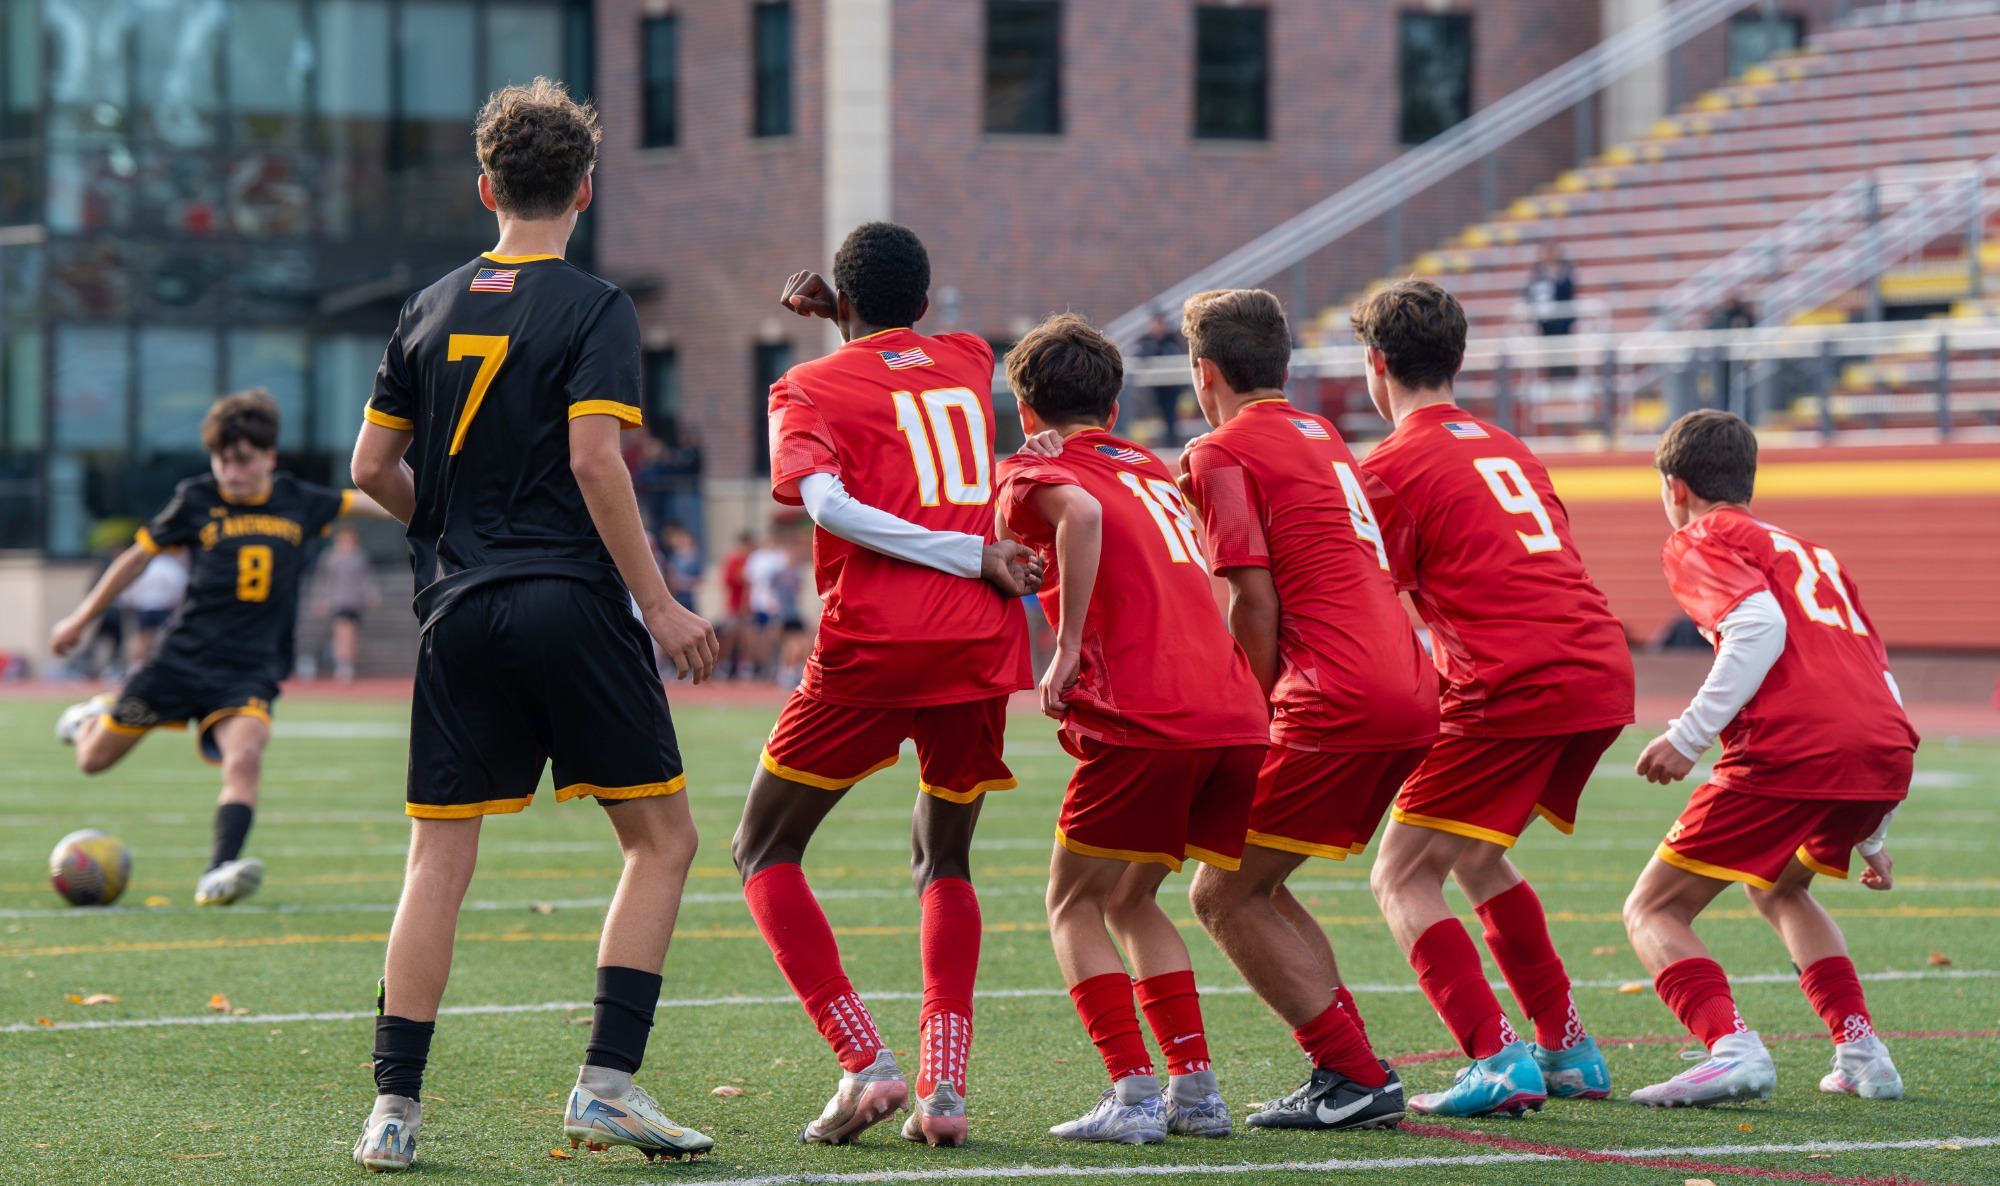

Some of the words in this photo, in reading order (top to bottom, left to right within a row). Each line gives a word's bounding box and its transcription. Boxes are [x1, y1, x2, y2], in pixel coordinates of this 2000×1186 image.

[447, 334, 509, 456] 7
[891, 387, 992, 507] 10
[1332, 461, 1390, 571] 4
[1473, 456, 1562, 554] 9
[236, 544, 273, 603] 8
[1769, 531, 1869, 637] 21
